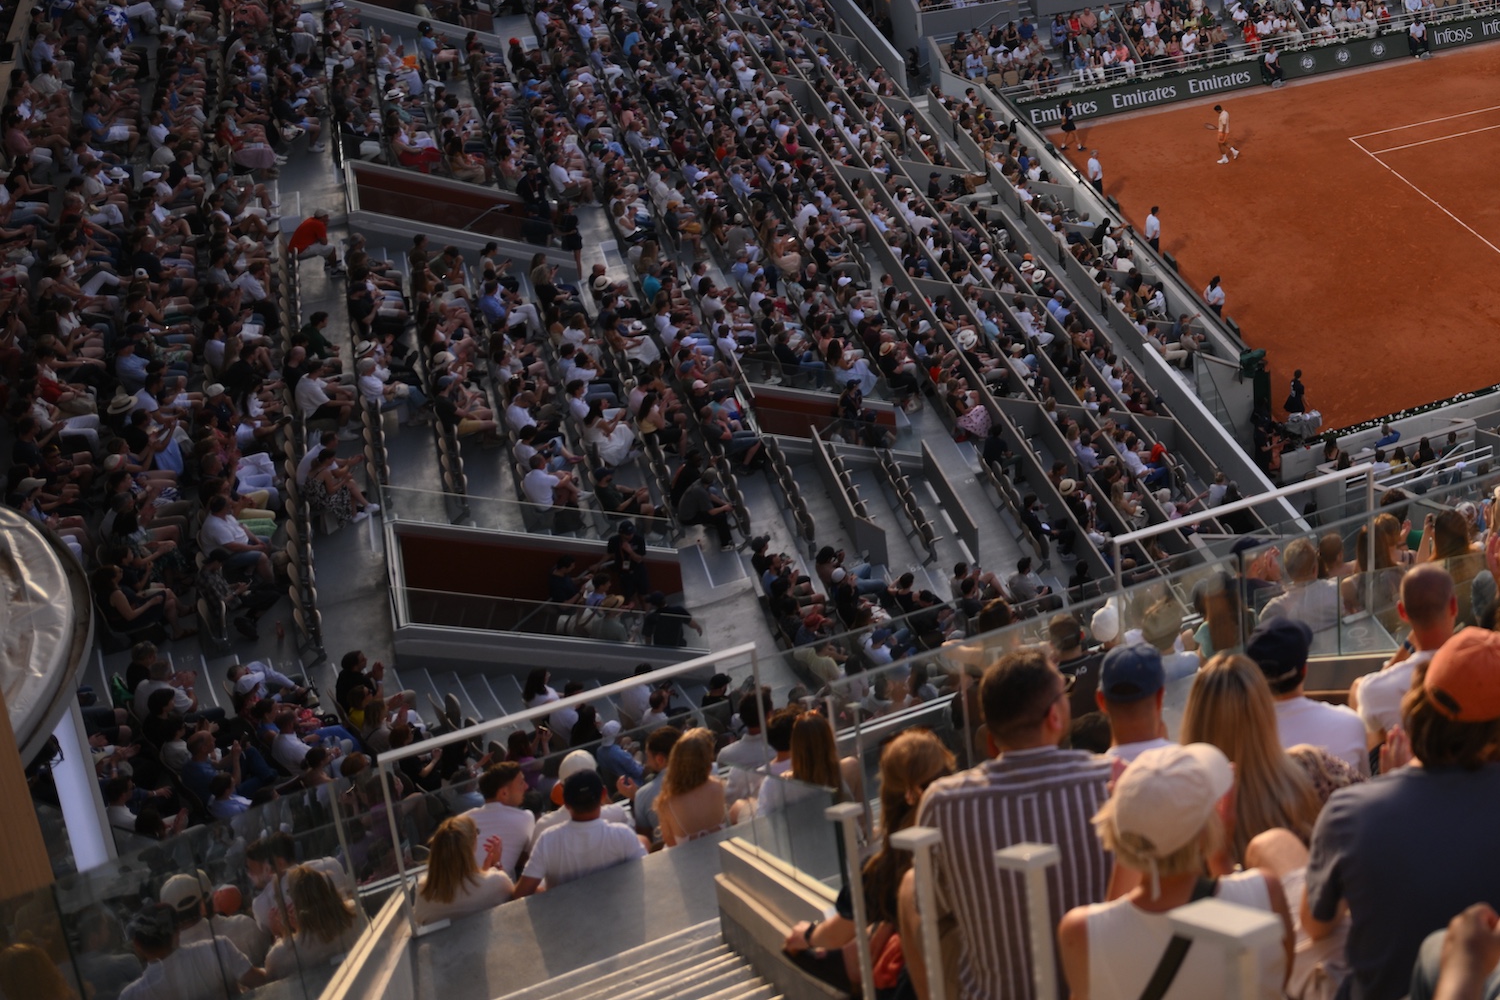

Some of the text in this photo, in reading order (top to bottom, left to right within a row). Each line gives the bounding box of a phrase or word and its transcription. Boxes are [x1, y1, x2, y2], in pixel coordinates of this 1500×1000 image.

[1433, 26, 1474, 45] Infosys
[1188, 71, 1251, 94] Emirates
[1112, 84, 1177, 109] Emirates
[1030, 101, 1098, 124] Emiates
